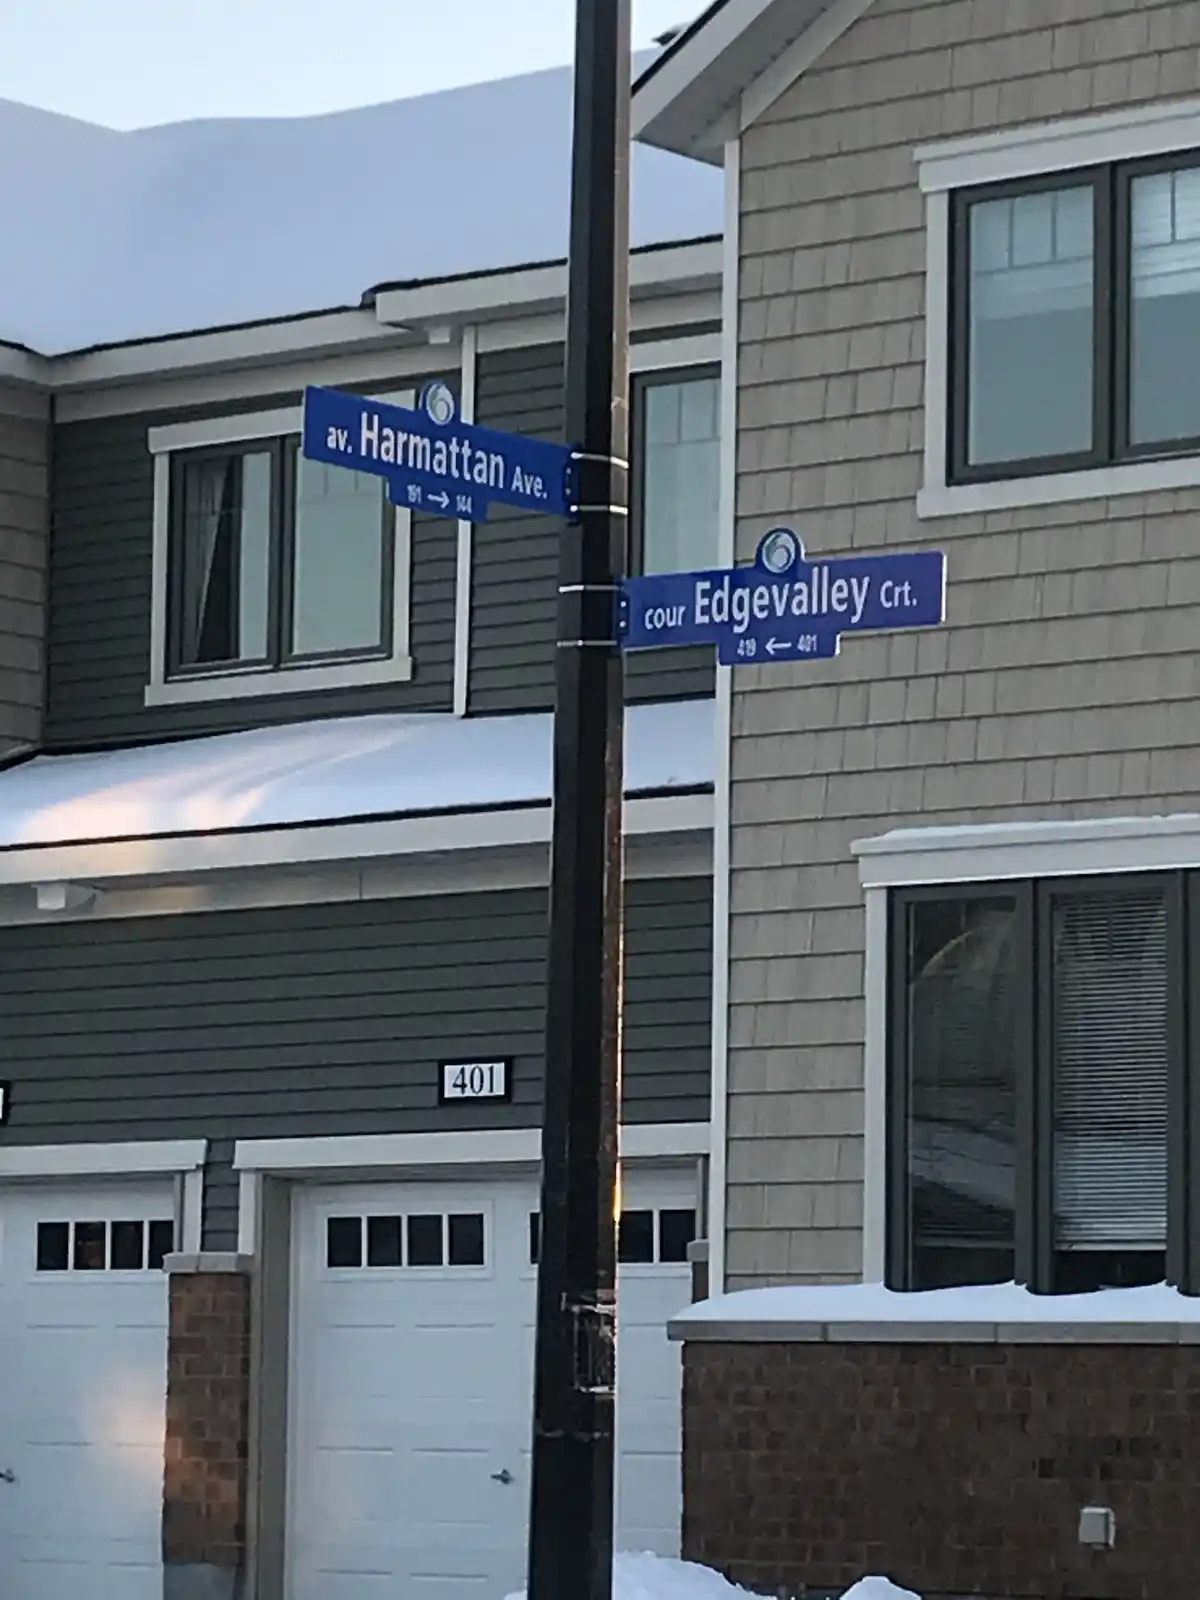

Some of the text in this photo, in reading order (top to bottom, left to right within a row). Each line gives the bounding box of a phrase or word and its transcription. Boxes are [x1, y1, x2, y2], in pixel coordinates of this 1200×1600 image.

[326, 411, 548, 499] av. Harmattan Ave.
[644, 565, 918, 633] cour Edgevalley Crt.
[452, 1065, 495, 1095] 401
